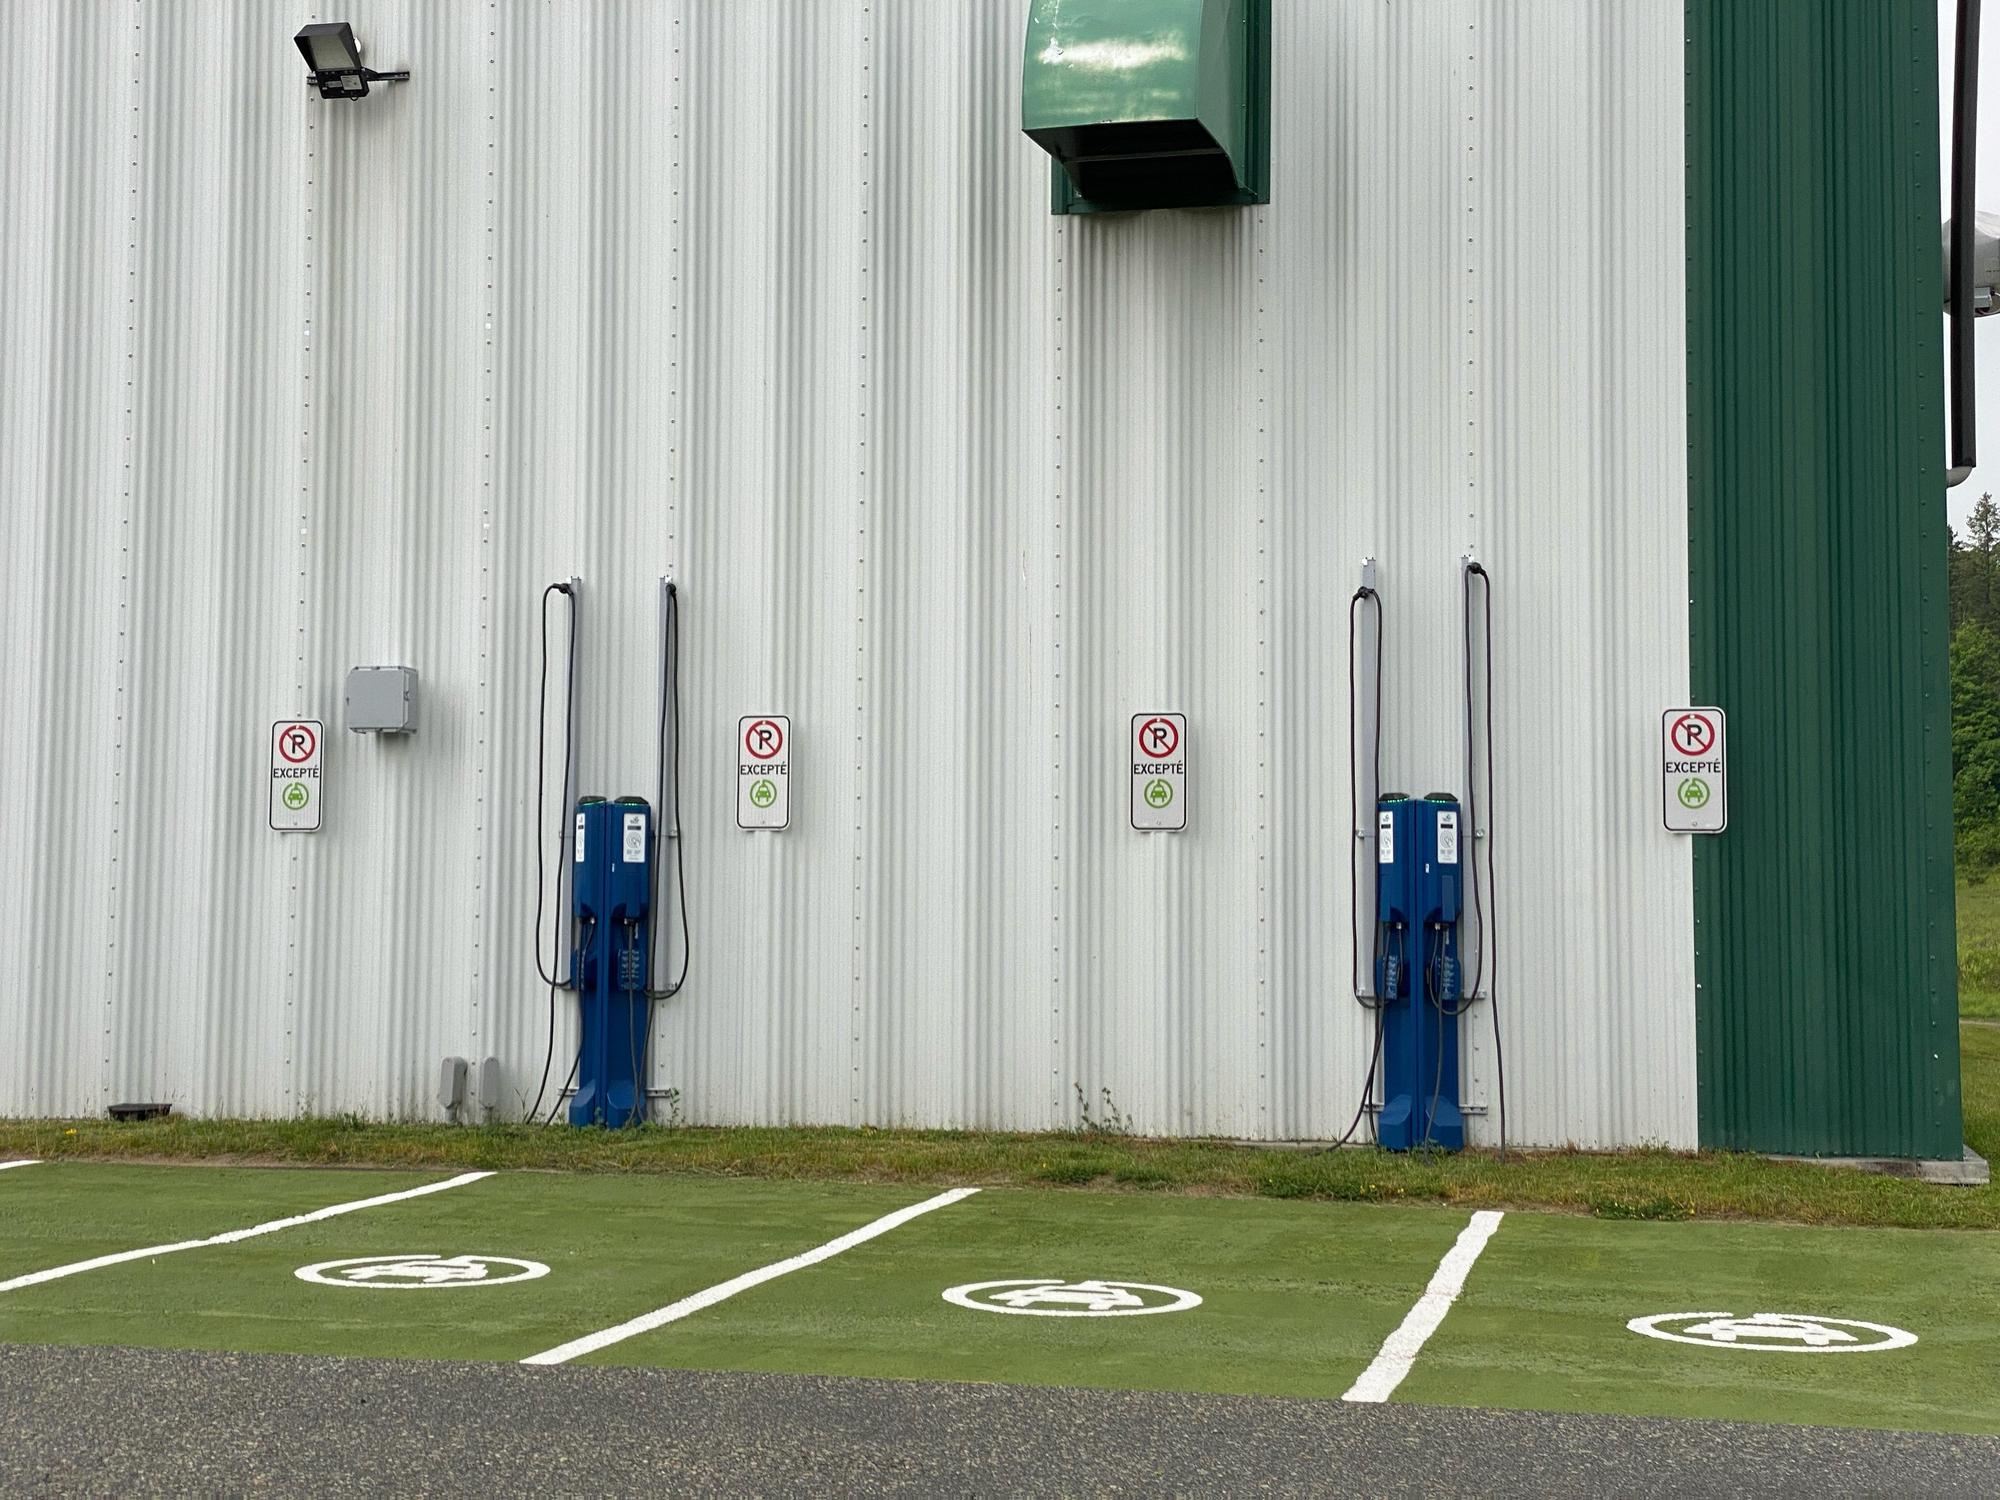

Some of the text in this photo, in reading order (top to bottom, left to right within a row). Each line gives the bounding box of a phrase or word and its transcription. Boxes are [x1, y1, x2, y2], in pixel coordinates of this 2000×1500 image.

[292, 734, 305, 754] P
[759, 729, 772, 750] P
[1153, 727, 1167, 748] P
[1687, 724, 1702, 746] P
[273, 765, 320, 778] EXCEPTÉ
[740, 761, 787, 775] EXCEPTÉ
[1133, 760, 1184, 775] EXCEPTÉ
[1665, 758, 1721, 774] EXCEPTÉ
